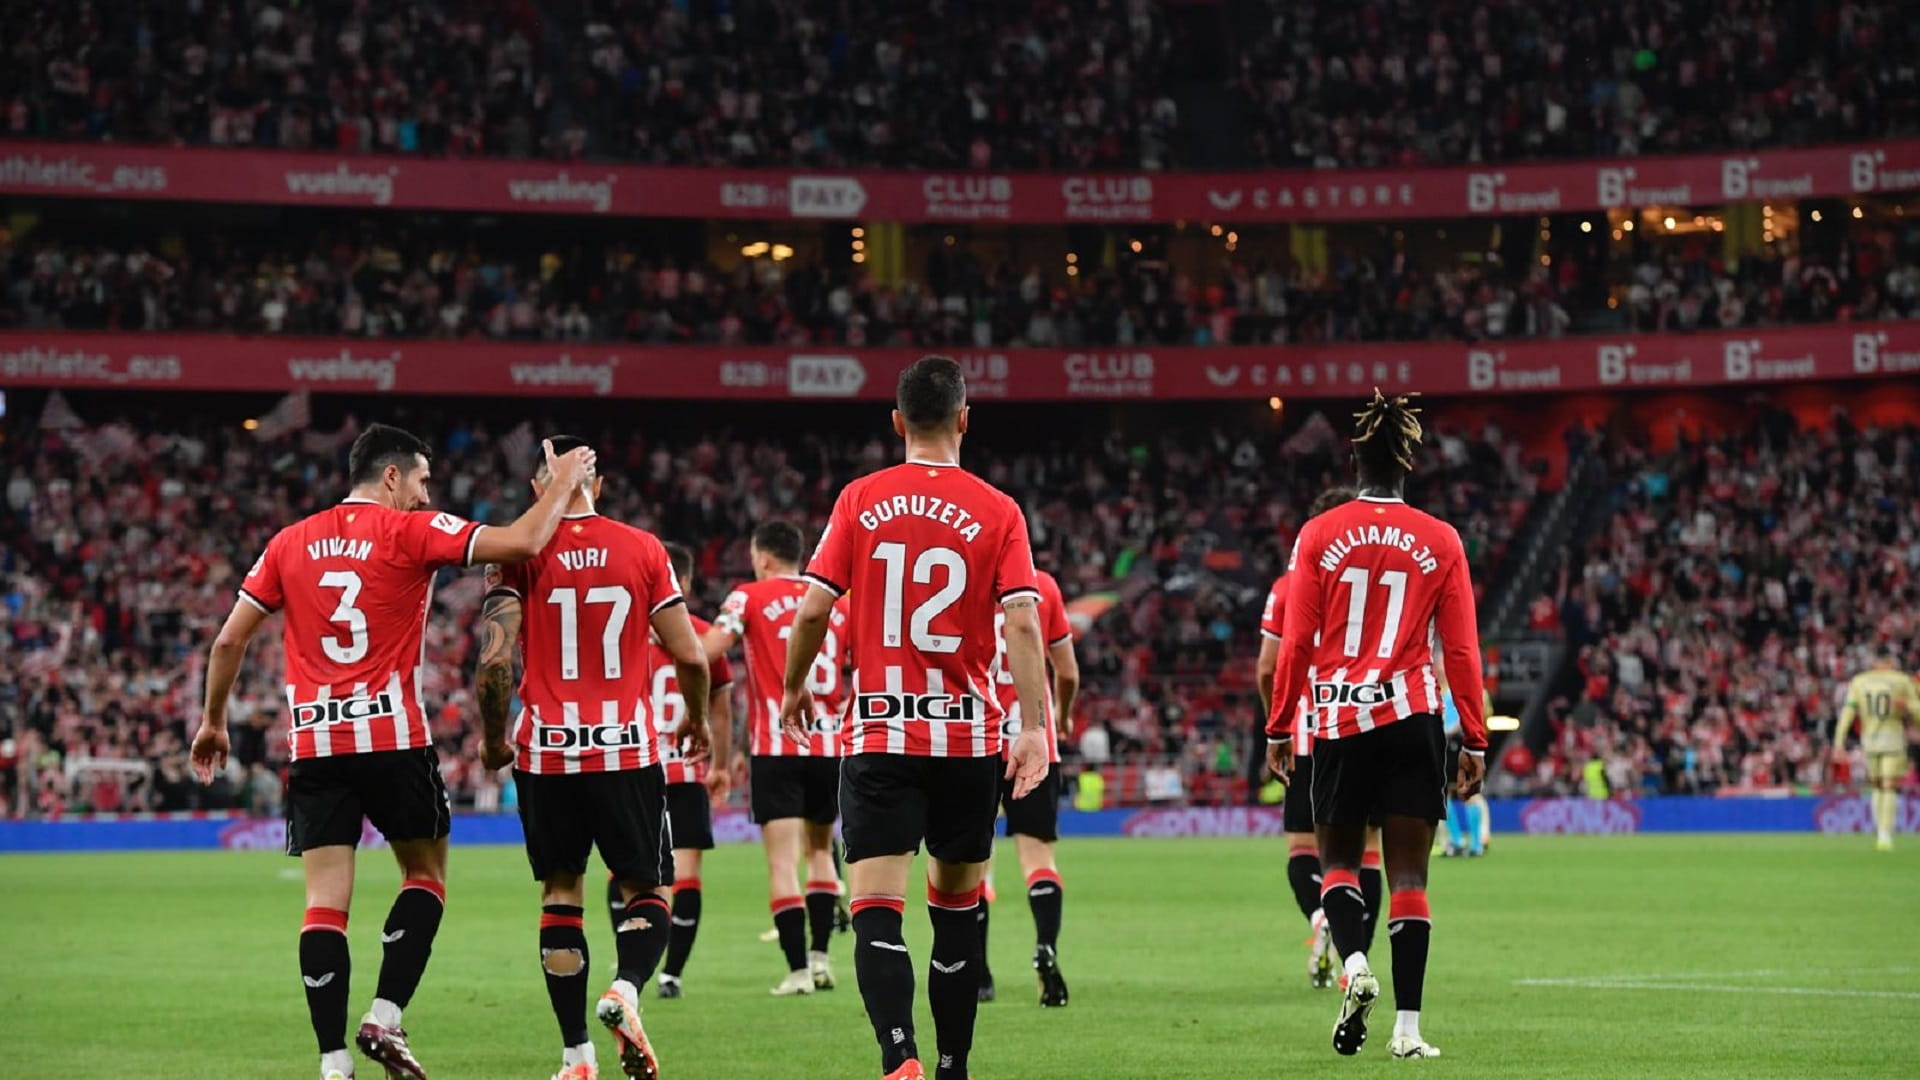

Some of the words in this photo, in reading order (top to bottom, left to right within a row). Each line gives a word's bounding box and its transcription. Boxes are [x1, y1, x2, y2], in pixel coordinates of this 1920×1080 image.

[0, 155, 167, 192] thletic_eus
[286, 163, 393, 205] vueling
[508, 171, 612, 212] vueling
[923, 176, 1012, 202] CLUB
[1062, 176, 1153, 203] CLUB
[1252, 184, 1413, 209] CASTORE
[287, 348, 396, 391] vueling
[510, 354, 613, 394] vueling
[1063, 353, 1154, 379] CLUB
[1250, 361, 1411, 386] CASTORE
[859, 495, 983, 543] GURUZETA
[557, 548, 608, 571] YURI
[1319, 525, 1416, 573] WILLIAMS
[1412, 546, 1438, 575] JR
[871, 541, 967, 653] 12
[1339, 566, 1408, 659] 11
[318, 570, 369, 665] 3
[547, 585, 632, 681] 17
[778, 626, 838, 696] 8
[292, 694, 393, 728] DIGI
[858, 695, 974, 721] DIGI
[1315, 682, 1395, 704] DIGI
[1865, 691, 1891, 720] 10
[539, 725, 641, 748] DIGI
